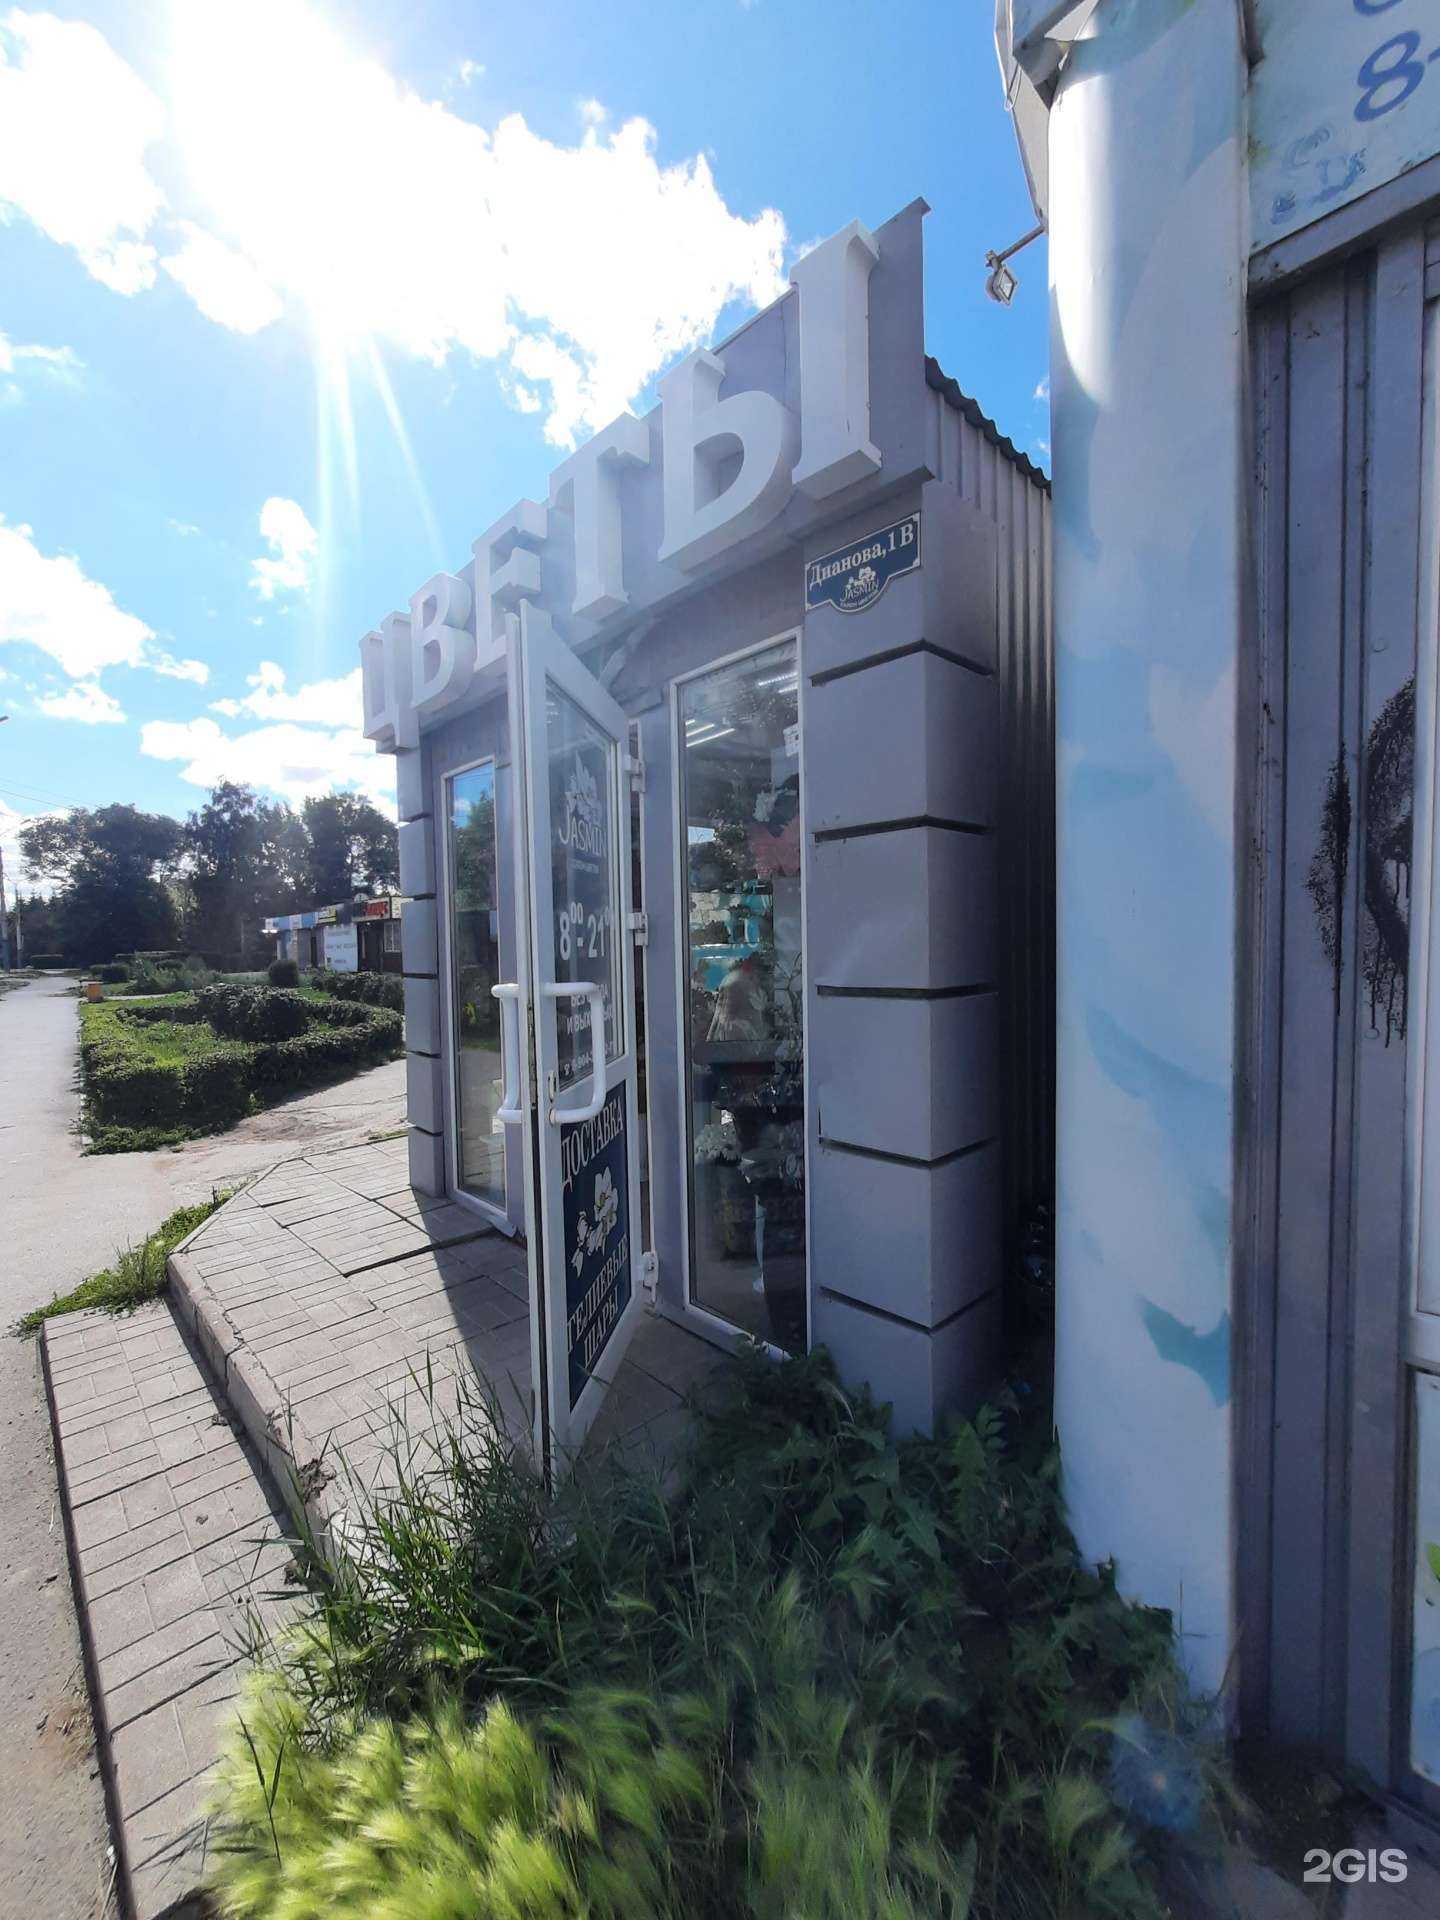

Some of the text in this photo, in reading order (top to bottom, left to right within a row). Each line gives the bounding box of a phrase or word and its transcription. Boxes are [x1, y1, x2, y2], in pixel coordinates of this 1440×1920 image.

[358, 217, 882, 755] ЦВЕТЫ
[558, 805, 608, 858] JASMIN
[561, 1095, 624, 1192] ДОСТАВКА
[567, 1233, 629, 1354] ГЕЛИЕВЫЕ
[584, 1285, 618, 1368] ШАРЫ
